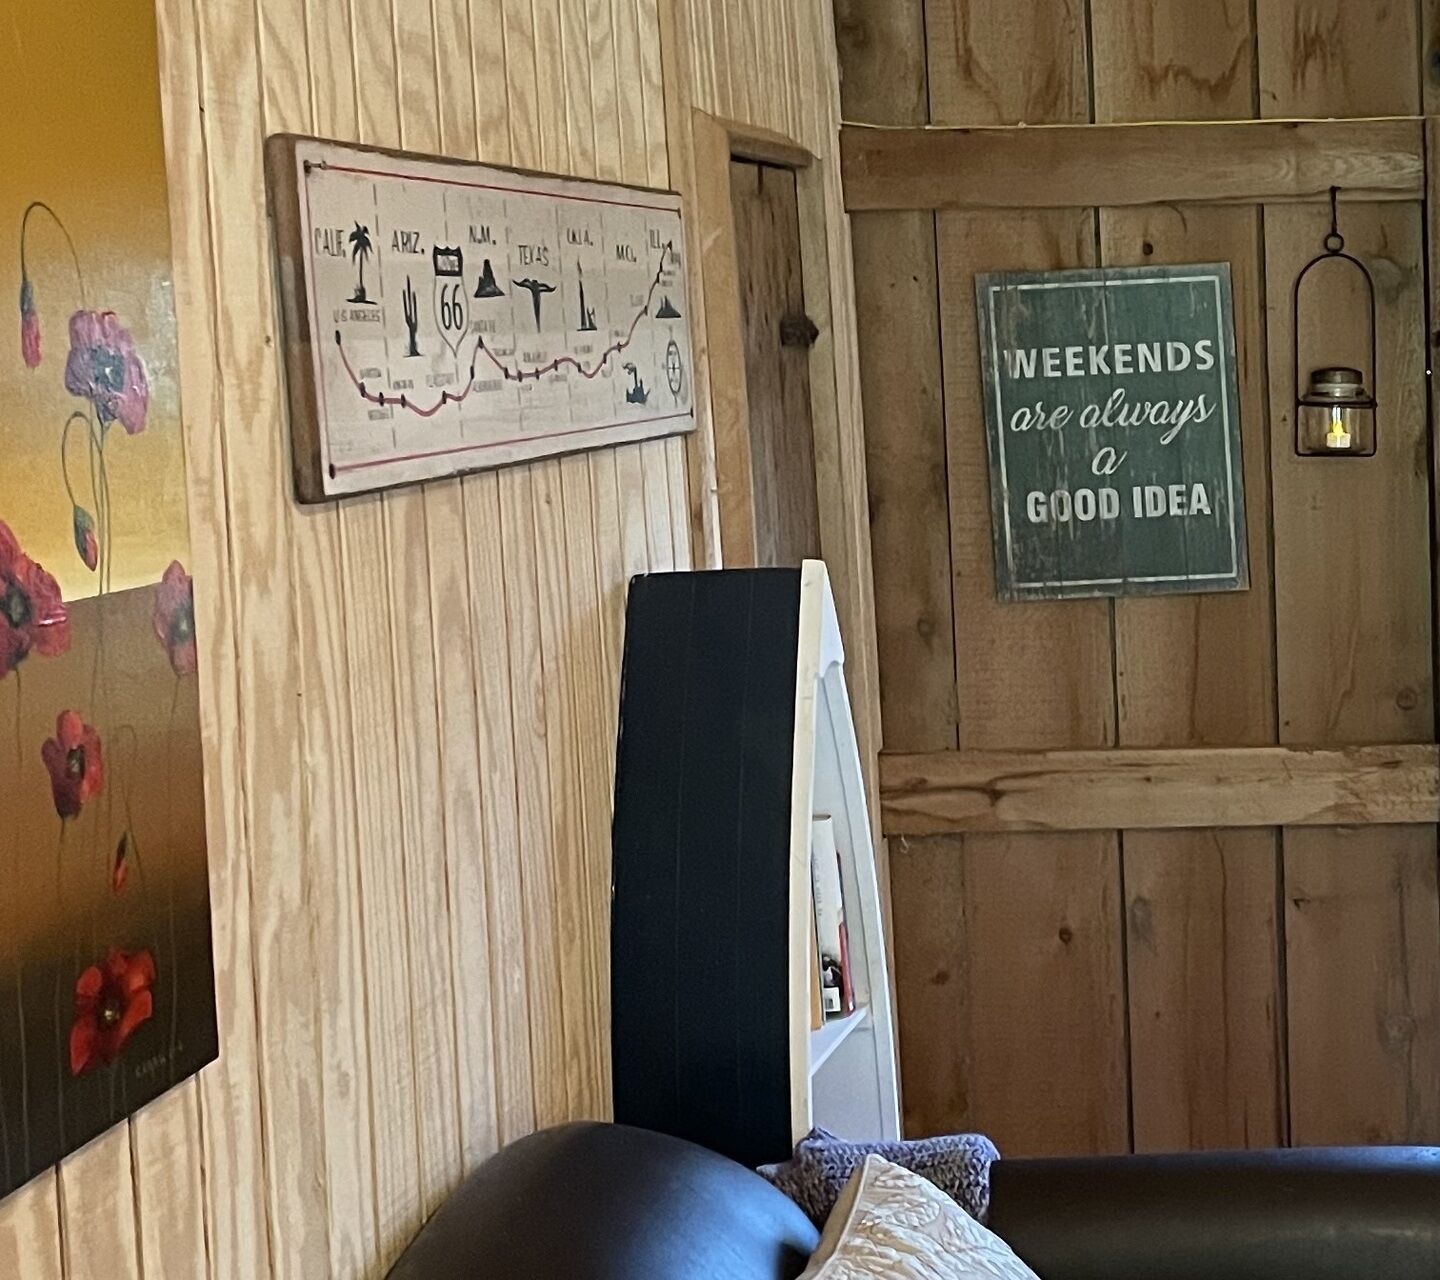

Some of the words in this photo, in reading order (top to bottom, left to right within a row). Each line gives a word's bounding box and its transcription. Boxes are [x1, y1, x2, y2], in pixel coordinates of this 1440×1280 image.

[391, 230, 425, 255] ARIZ.
[518, 244, 549, 267] TEXAS
[441, 283, 463, 330] 66
[1004, 340, 1215, 379] WEEKENDS
[1010, 401, 1075, 432] are
[1079, 388, 1217, 445] always
[1091, 447, 1128, 475] a
[1027, 487, 1121, 523] GOOD
[1132, 483, 1212, 519] IDEA
